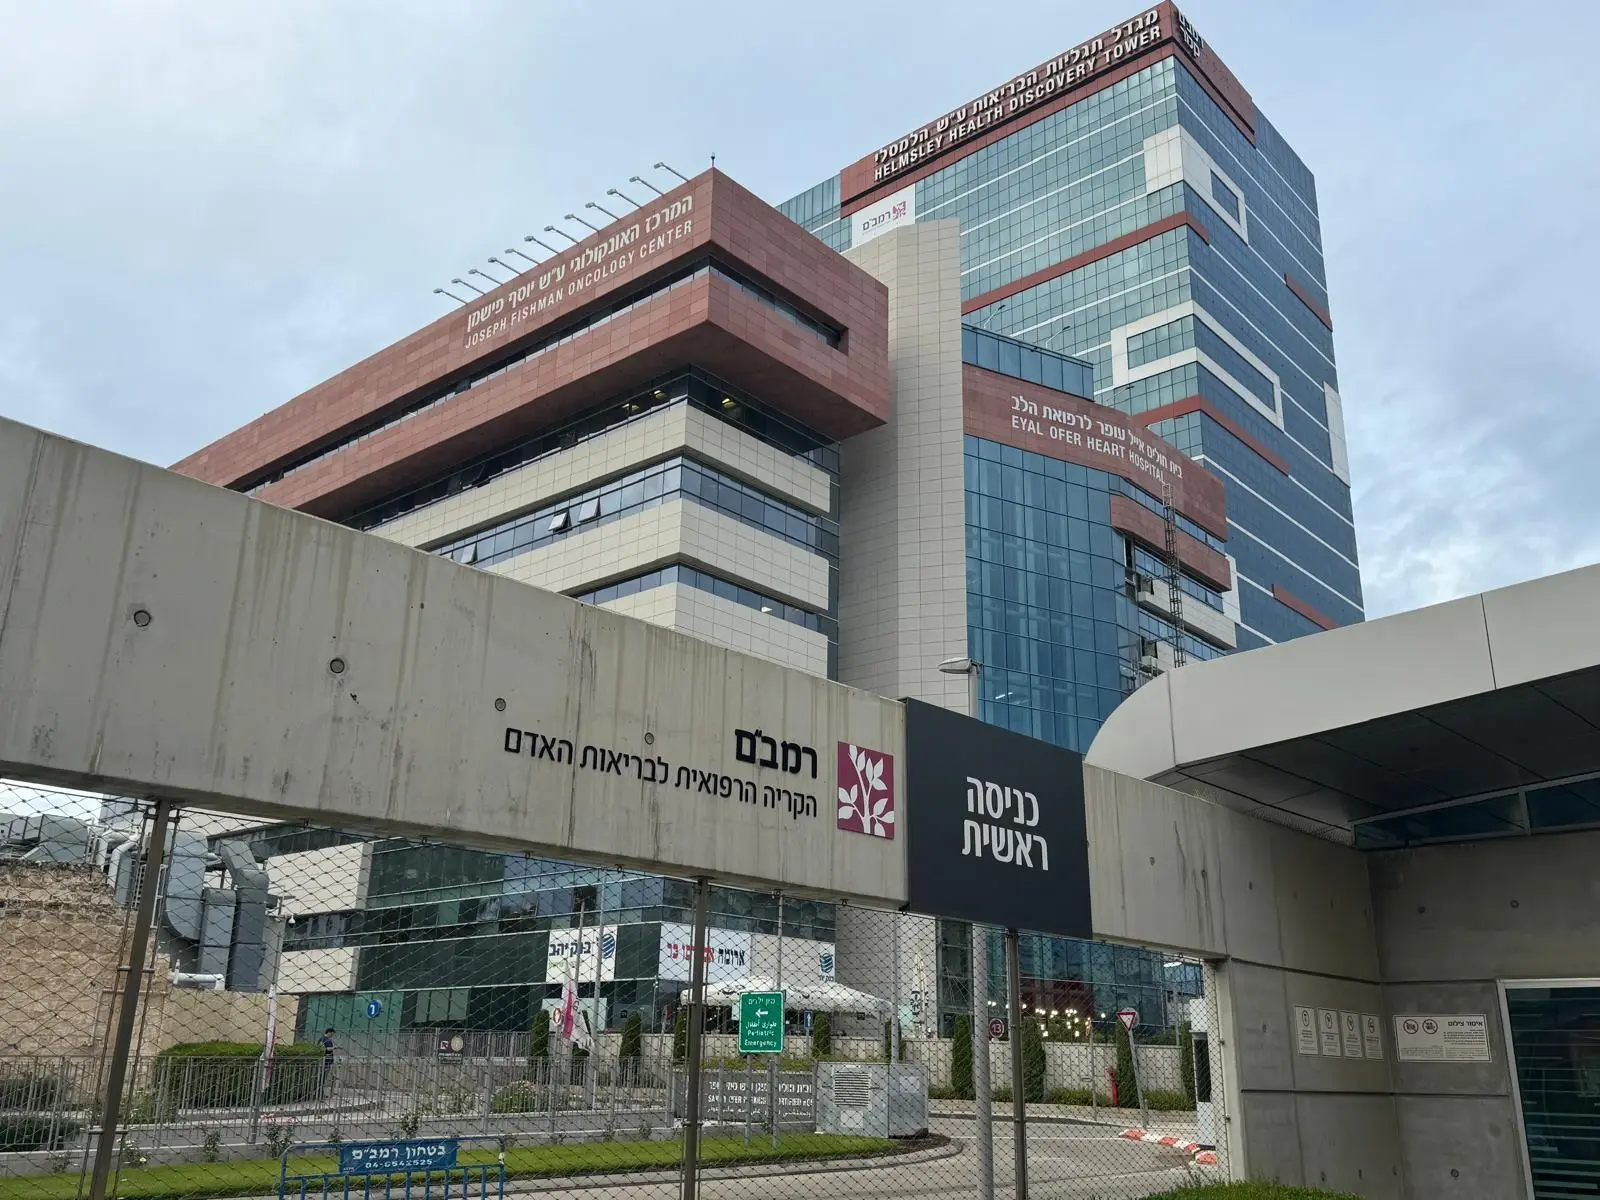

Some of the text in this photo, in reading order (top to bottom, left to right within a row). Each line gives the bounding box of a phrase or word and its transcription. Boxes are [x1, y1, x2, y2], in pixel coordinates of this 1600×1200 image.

[1111, 9, 1159, 41] מגדל
[1046, 38, 1104, 77] תגליות
[874, 25, 1161, 182] HELMSLEY HEALTH DISCOVERY TOWER
[972, 72, 1038, 115] הבריאות
[874, 128, 930, 164] הלמסלי
[644, 195, 693, 234] המרכז
[570, 223, 640, 273] האונקולוגי
[465, 219, 692, 349] JOSEPH FISHMAN ONCOLOGY CENTER
[508, 285, 534, 309] יוסף
[466, 298, 504, 332] פישמן
[1011, 395, 1183, 479] בית חולים אייל עופר לרפואת הלב
[1012, 415, 1165, 484] EYAL OFER HEART HOSPITAL
[504, 727, 818, 819] הקריה הרפואית לבריאות האדם
[967, 776, 1040, 827] כניסה
[962, 819, 1049, 871] ראשית
[744, 1039, 777, 1047] Emergency
[406, 1145, 447, 1160] בטחון
